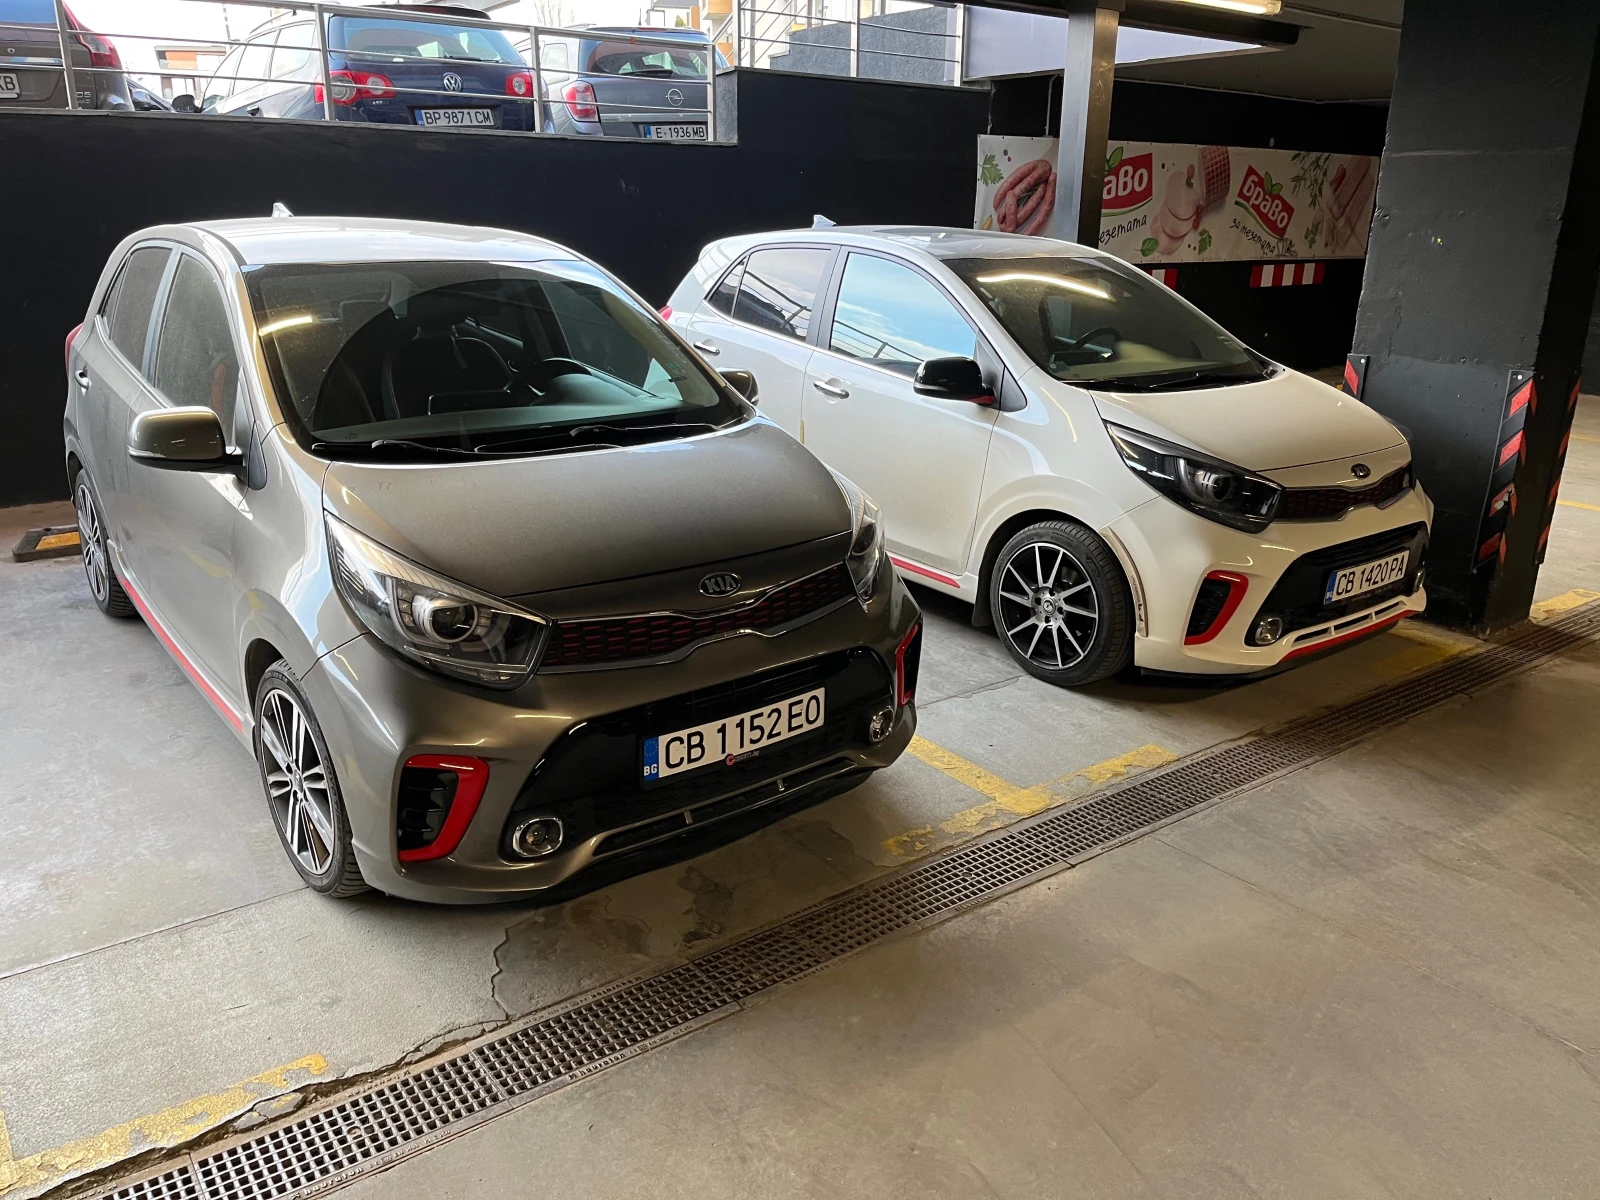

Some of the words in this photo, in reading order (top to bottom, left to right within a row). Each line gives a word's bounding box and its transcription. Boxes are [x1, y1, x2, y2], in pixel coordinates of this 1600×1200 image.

[424, 111, 441, 125] BP
[443, 110, 473, 125] 9871
[474, 110, 492, 124] CM
[655, 127, 663, 139] E
[668, 127, 691, 138] 1936
[692, 126, 705, 138] MB
[704, 575, 737, 593] KIA
[1336, 571, 1356, 596] CB
[1359, 560, 1389, 590] 1420
[1388, 555, 1405, 580] PA
[665, 730, 706, 769] CB
[716, 707, 782, 755] 1152
[787, 694, 821, 733] EO
[643, 763, 658, 777] BG
[303, 1166, 364, 1196] hauraton
